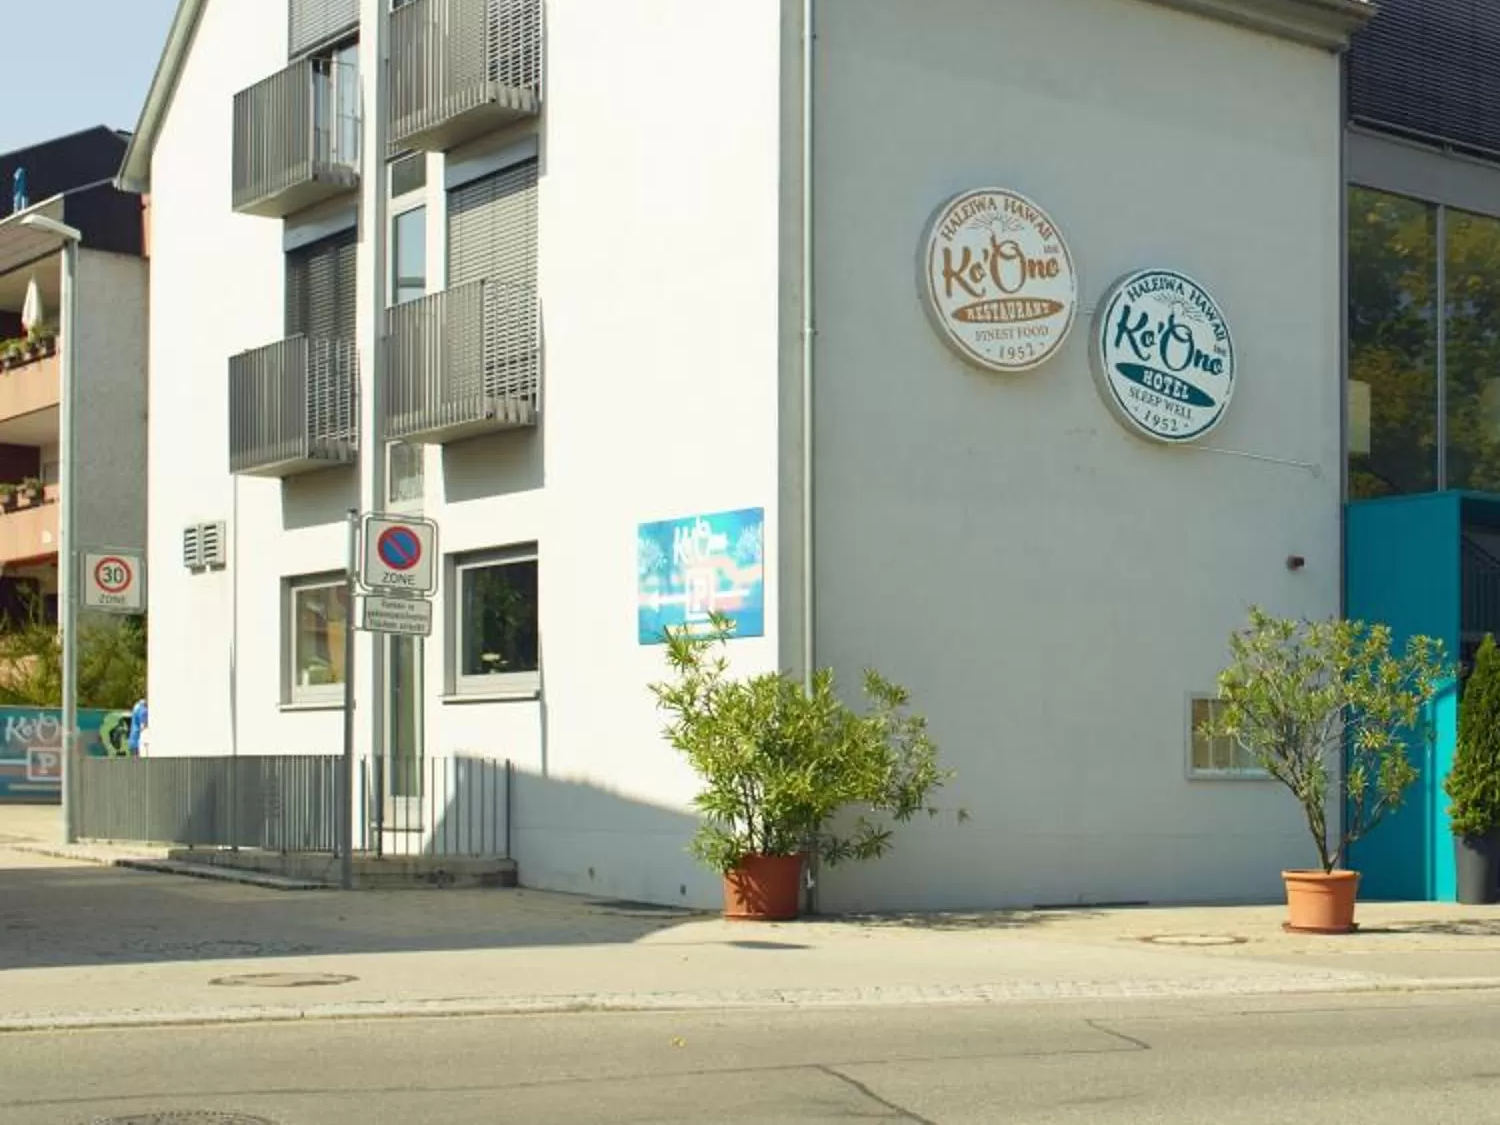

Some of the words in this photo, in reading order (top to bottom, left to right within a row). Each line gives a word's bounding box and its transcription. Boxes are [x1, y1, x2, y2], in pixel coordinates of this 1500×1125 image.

[941, 196, 997, 242] HALEIWA
[1004, 198, 1054, 241] HAWAII
[966, 300, 1050, 320] RESTAURANT
[1127, 277, 1184, 302] HALEIWA
[1189, 290, 1226, 341] HAWAII
[975, 329, 1014, 342] FINEST
[1018, 326, 1049, 339] FOOD
[1000, 342, 1035, 360] 1952
[1142, 369, 1190, 400] HOTEL
[1129, 386, 1162, 407] SLEEP
[1164, 400, 1192, 420] WELL
[1143, 410, 1179, 432] 1952
[103, 566, 125, 584] 30
[380, 571, 416, 586] ZONE
[98, 594, 126, 604] ZONE
[38, 752, 57, 774] P
